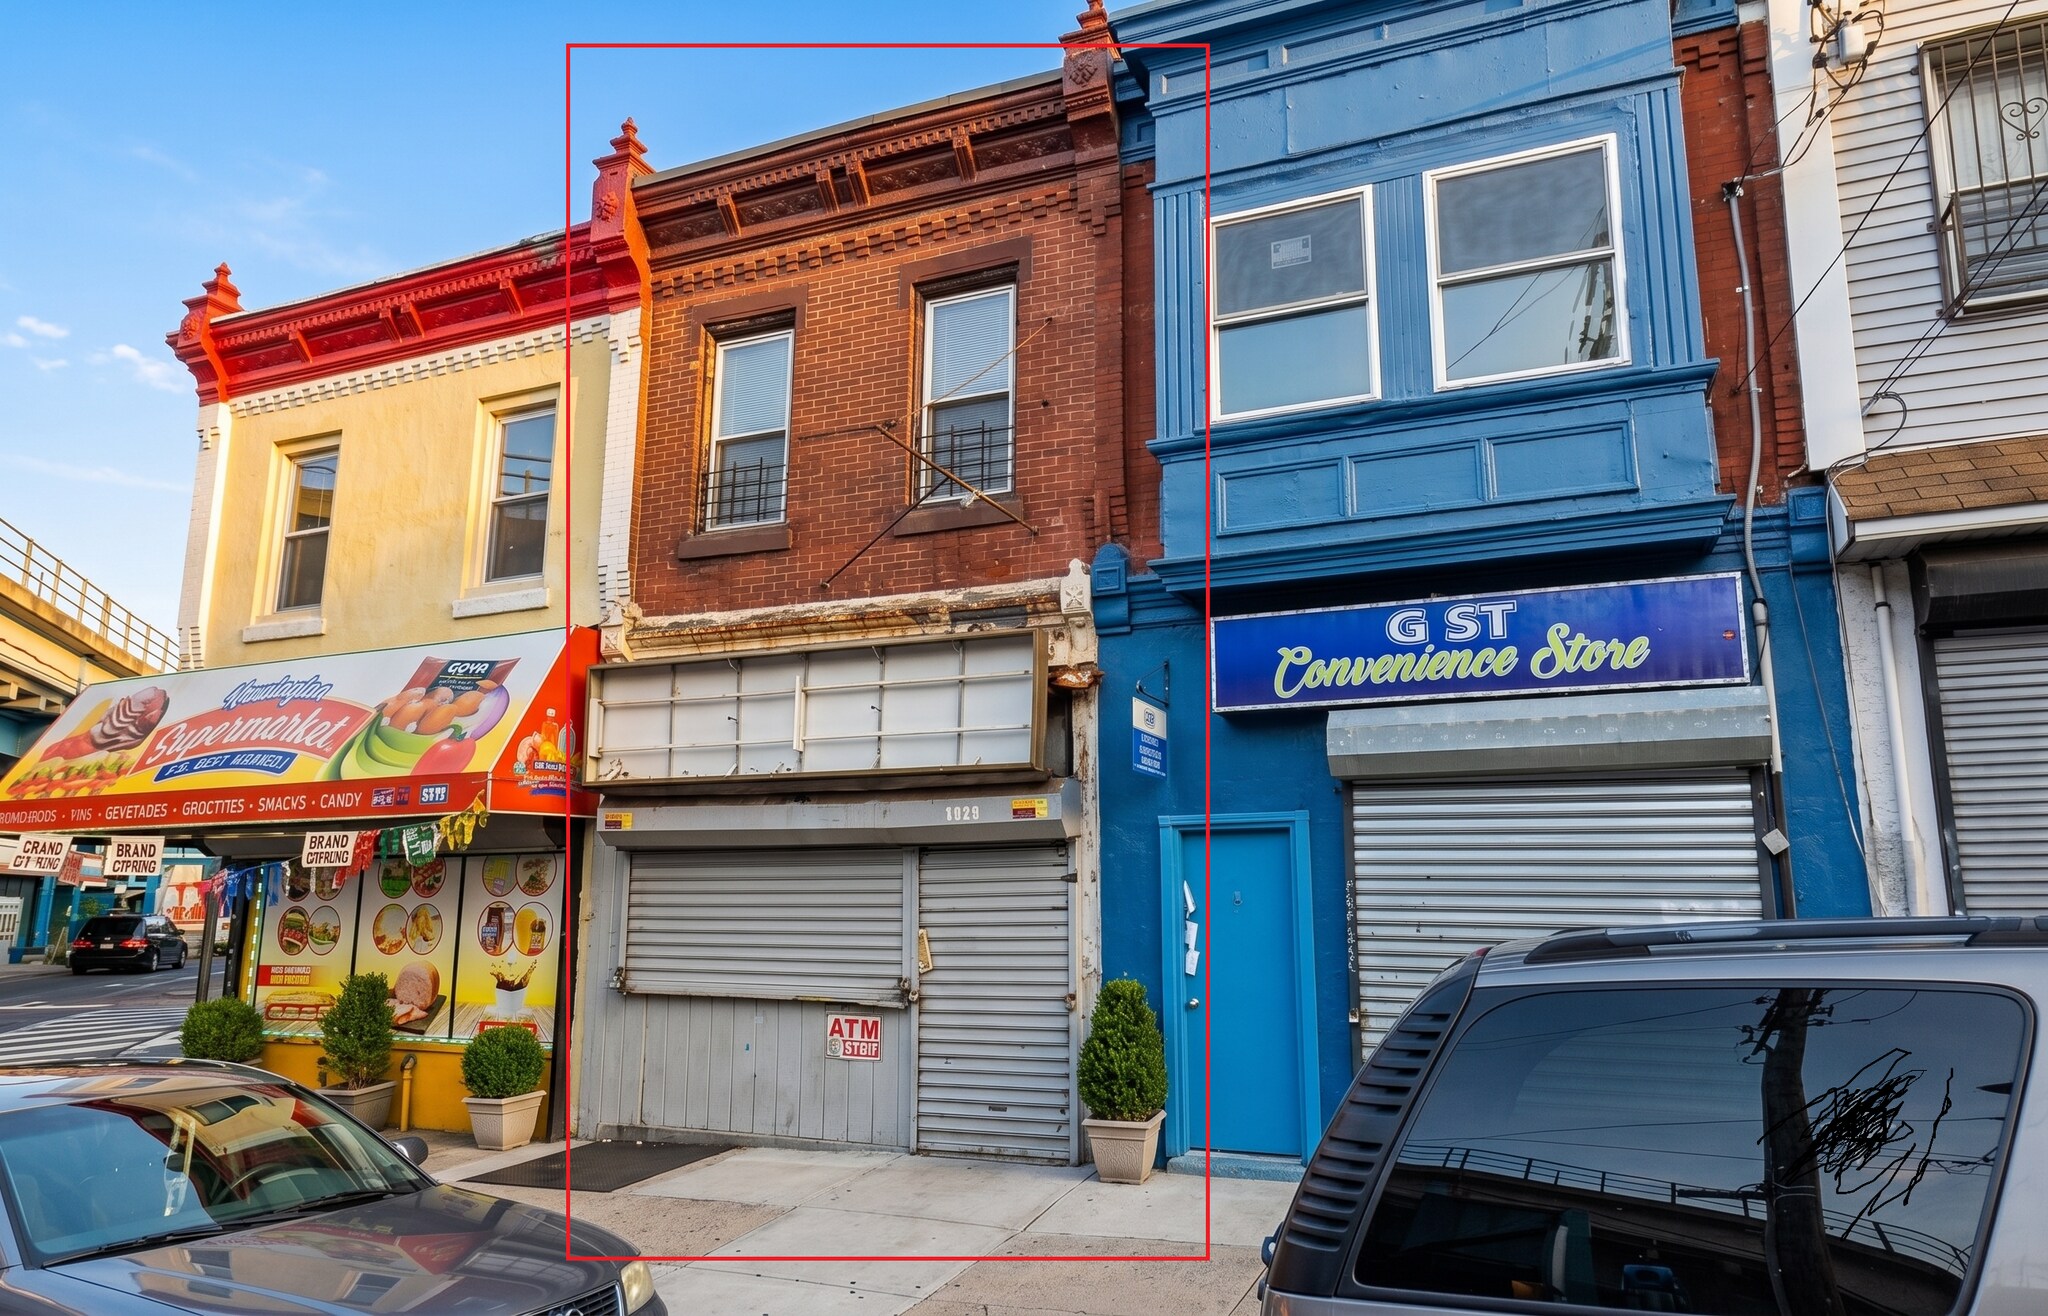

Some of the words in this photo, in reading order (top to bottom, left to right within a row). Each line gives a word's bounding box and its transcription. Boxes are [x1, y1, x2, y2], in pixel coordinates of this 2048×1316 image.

[1386, 608, 1429, 645] G
[1445, 600, 1517, 643] ST
[447, 662, 490, 675] GOYA
[1274, 645, 1518, 699] Convenience
[1530, 622, 1651, 680] Store
[145, 707, 350, 765] Supermarket
[320, 792, 363, 809] CANDY
[116, 843, 157, 858] BRAND
[309, 834, 349, 850] BRAND
[828, 1018, 880, 1040] ATM
